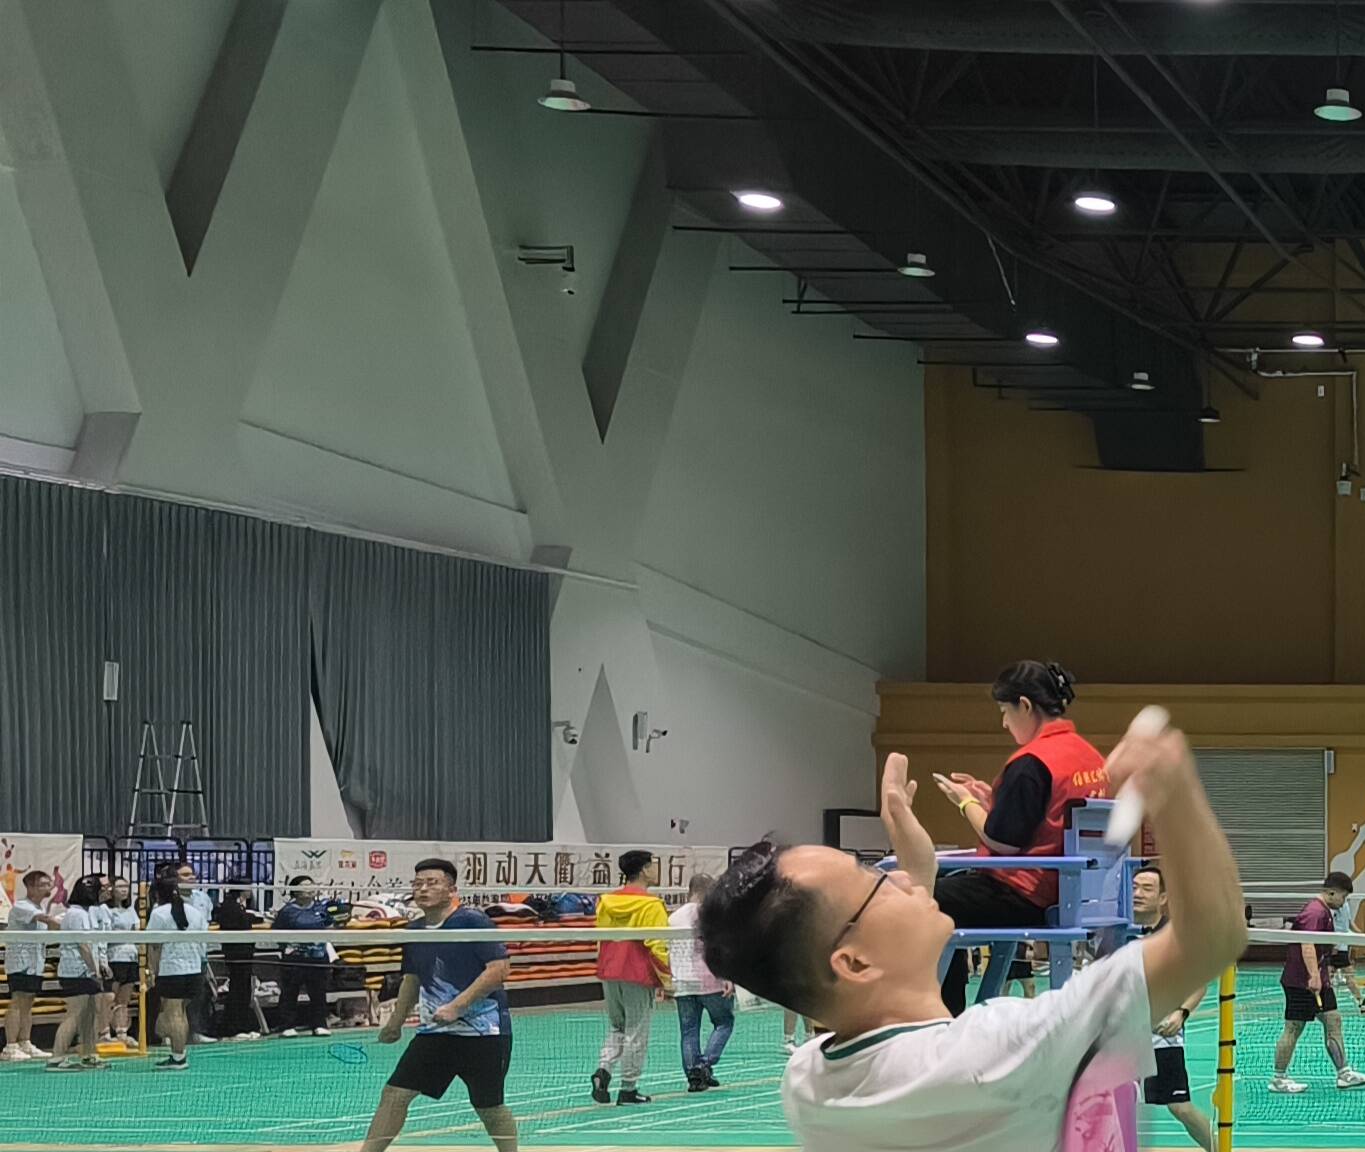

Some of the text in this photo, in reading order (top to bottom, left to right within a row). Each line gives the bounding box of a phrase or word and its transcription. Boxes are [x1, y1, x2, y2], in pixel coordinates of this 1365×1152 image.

[464, 850, 687, 887] 羽动天衢 益行
